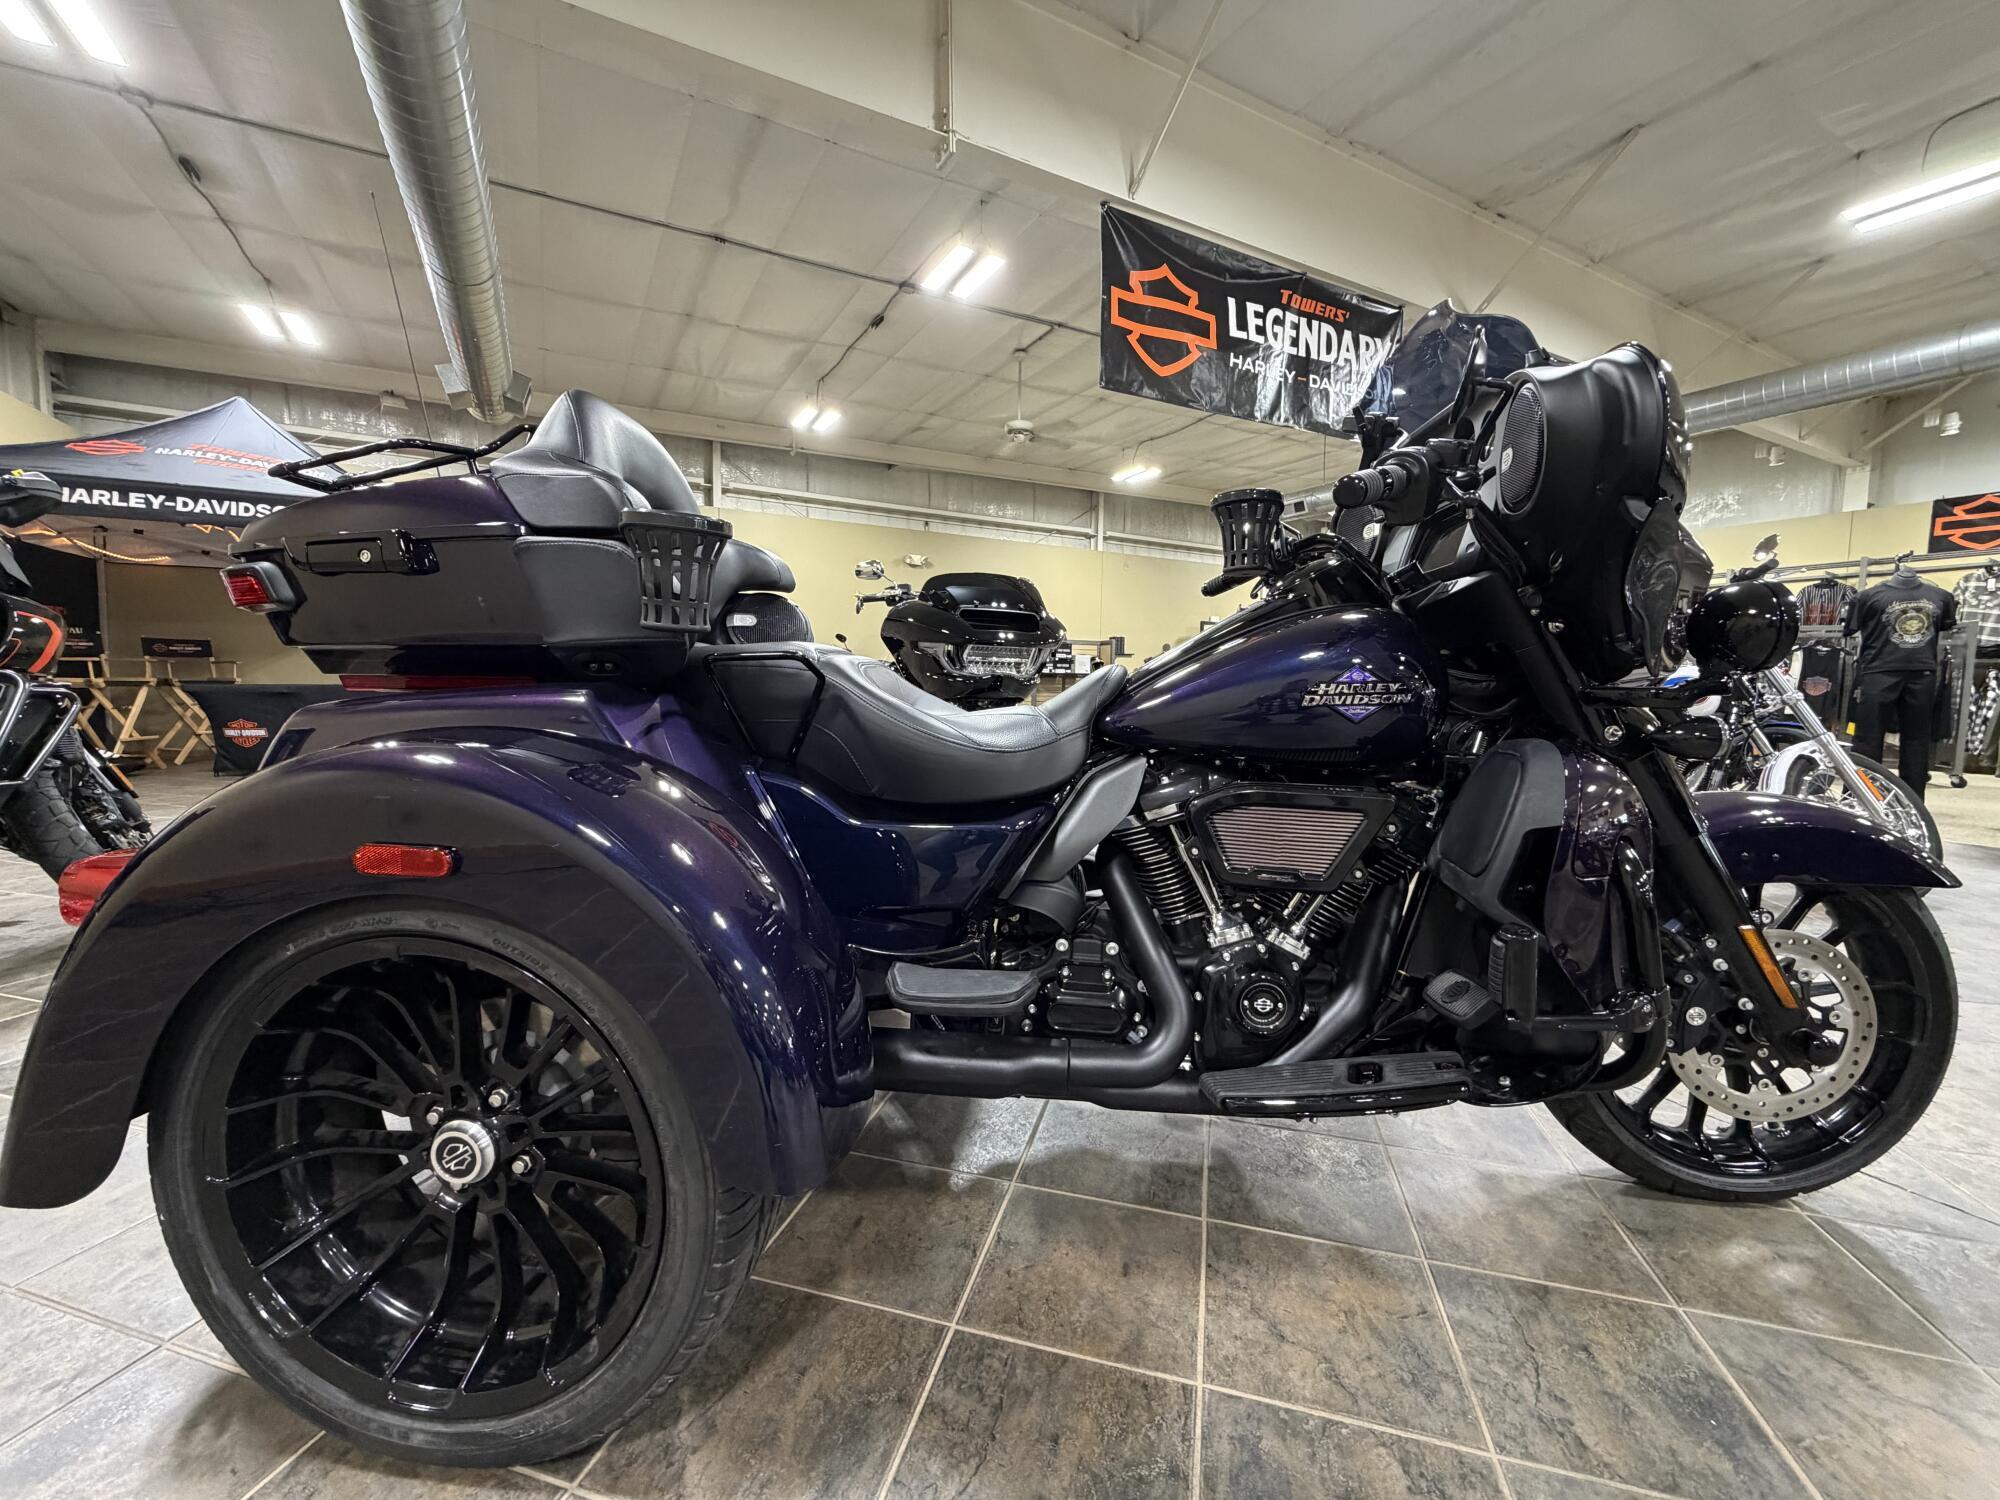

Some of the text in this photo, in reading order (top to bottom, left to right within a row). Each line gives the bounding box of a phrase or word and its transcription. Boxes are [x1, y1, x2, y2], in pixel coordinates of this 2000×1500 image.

[1280, 289, 1349, 323] TOWERS'
[1227, 296, 1391, 371] LEGENDARY
[61, 486, 286, 518] ARLEY-DAVIDS
[1301, 694, 1412, 706] DAVIDSON
[1317, 683, 1402, 694] HARLEY
